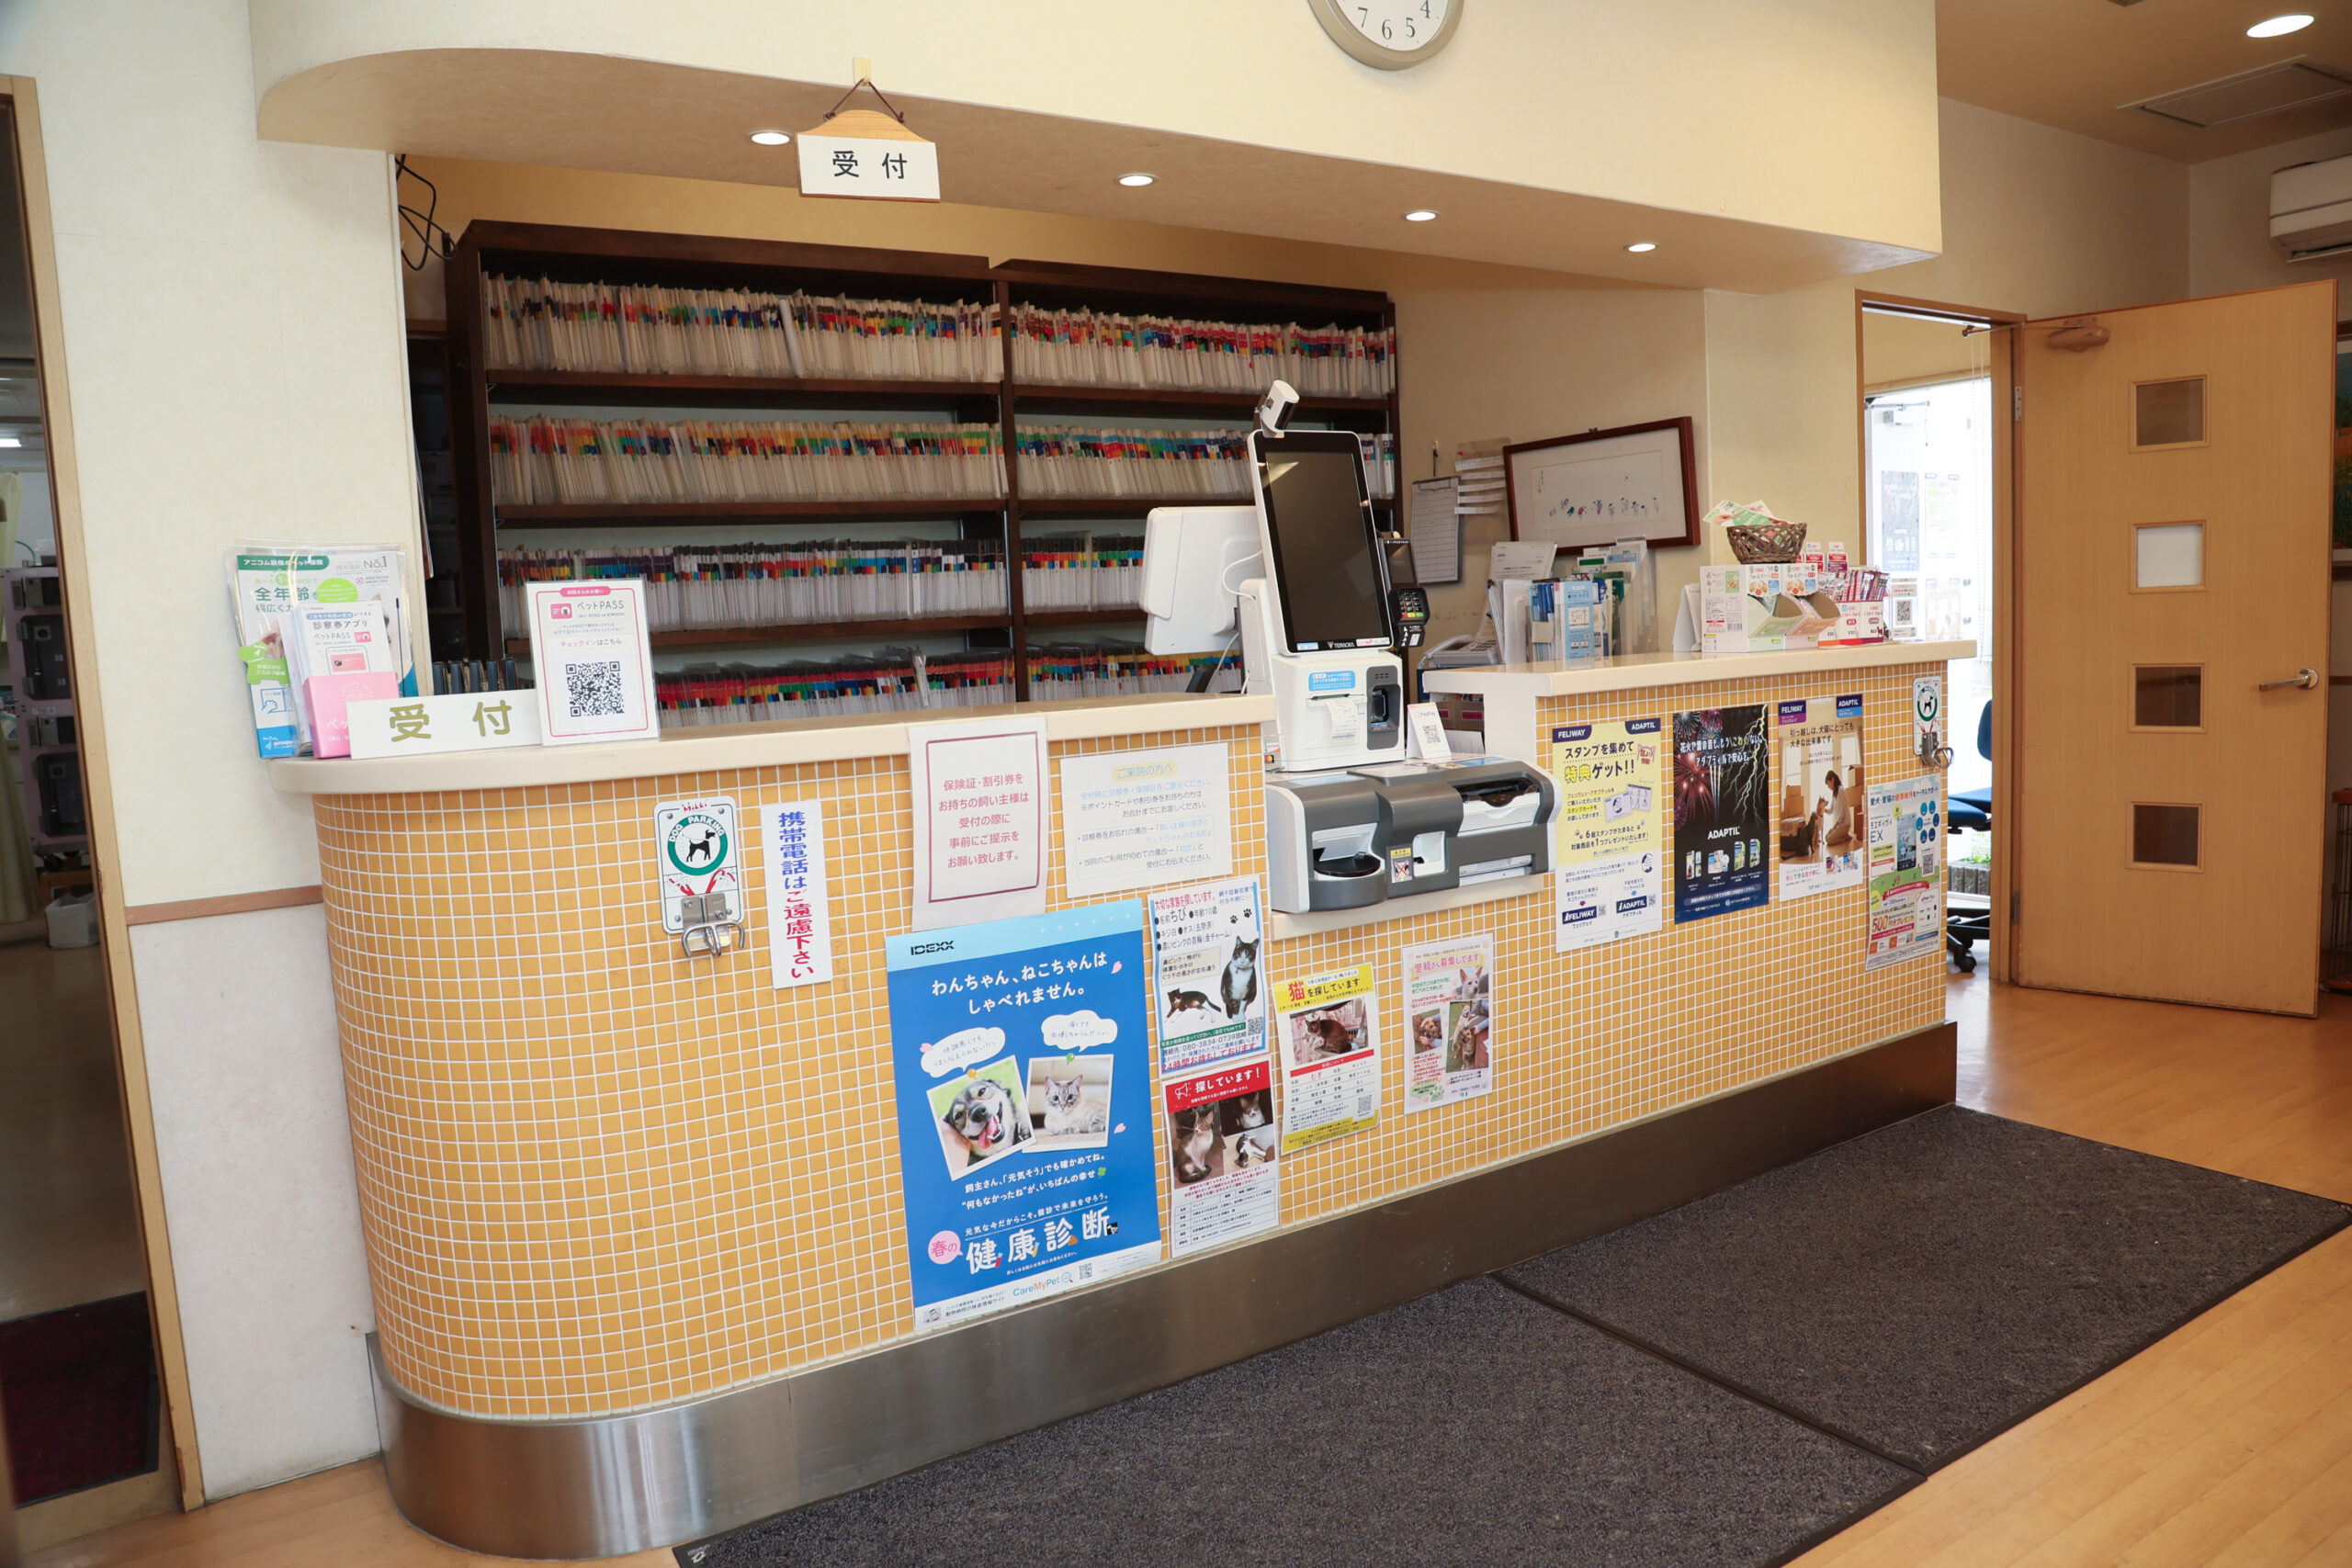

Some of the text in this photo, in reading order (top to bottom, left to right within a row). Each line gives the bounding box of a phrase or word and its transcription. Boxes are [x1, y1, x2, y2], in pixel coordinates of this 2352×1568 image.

[1358, 6, 1368, 28] 7
[1419, 0, 1430, 18] 4
[1382, 19, 1392, 39] 6
[1406, 17, 1415, 38] 5
[832, 151, 907, 179] 受付
[577, 600, 624, 610] ペットPASS
[313, 621, 368, 629] 診察券アプリ
[560, 638, 622, 648] チェックインはこちら
[1781, 705, 1804, 714] FELIWAY
[1838, 699, 1859, 707] ADAPTIL
[390, 700, 512, 742] 受付
[1790, 722, 1854, 738] 引っ越しは、犬猫にとっても
[1558, 722, 1657, 739] FELIWAY ADAPTIL
[1566, 741, 1634, 759] スタンプを集めて
[1790, 735, 1834, 749] 大きな出来事です。
[1117, 763, 1174, 779] ご来院の方へ
[1565, 760, 1634, 784] 特典ゲット!!
[944, 773, 1023, 791] 保険証・割引券を
[938, 792, 1029, 812] お持ちの飼い主様は
[669, 815, 724, 842] DOG PARKING
[958, 813, 1011, 829] 受付の際に
[949, 831, 1020, 849] 事前にご提示を
[1586, 826, 1634, 839] 6個スタンプがたまると
[1707, 827, 1740, 840] ADAPTIL
[1871, 829, 1883, 843] EX
[947, 850, 1020, 868] お願い致します。
[778, 811, 814, 978] 携帯電話はご遠慮下さい
[1623, 899, 1645, 909] ADAPTIL
[1569, 909, 1596, 921] FELIWAY
[910, 940, 955, 956] IDEXX
[932, 951, 1108, 997] わんちゃん、ねこちゃんは
[968, 982, 1085, 1015] しゃべれません。
[1288, 981, 1305, 1001] 猫
[1307, 978, 1360, 997] を探しています
[931, 1239, 957, 1258] 春の
[967, 1207, 1111, 1275] 健康診断
